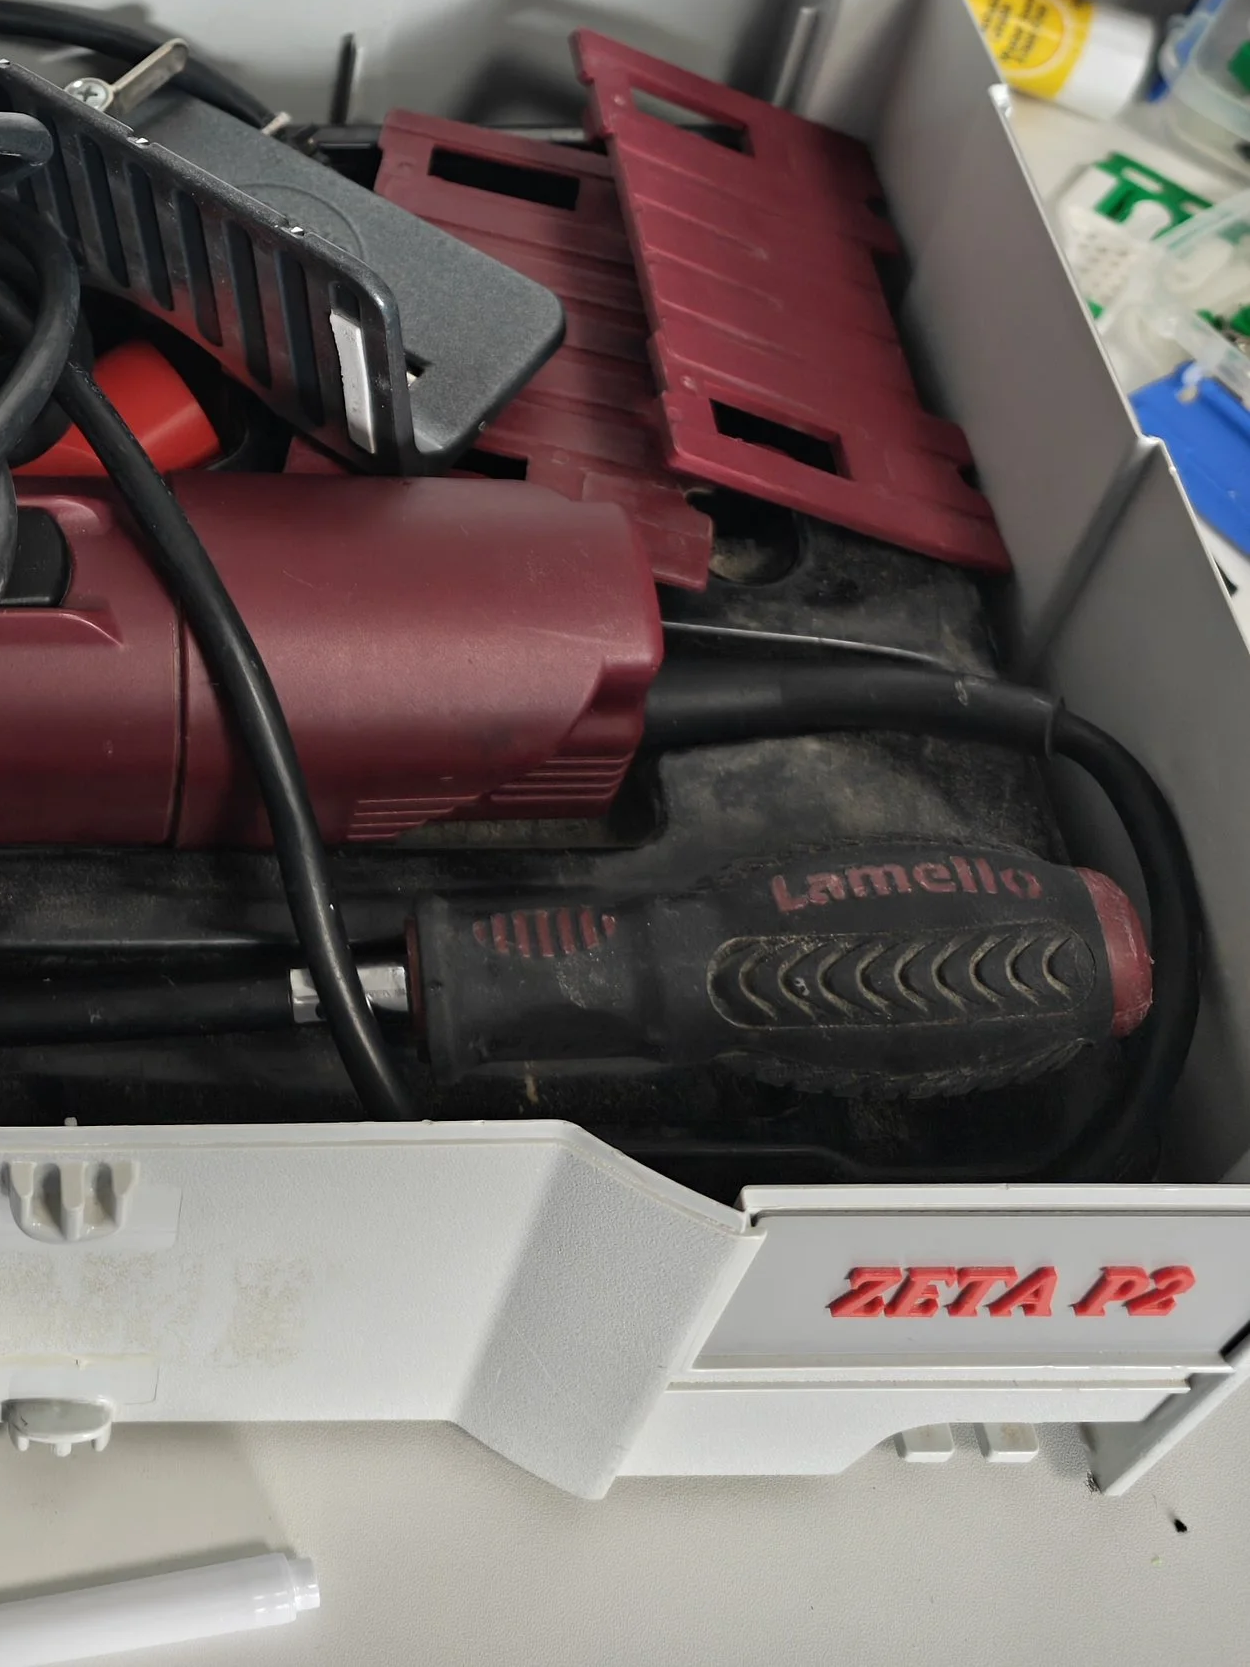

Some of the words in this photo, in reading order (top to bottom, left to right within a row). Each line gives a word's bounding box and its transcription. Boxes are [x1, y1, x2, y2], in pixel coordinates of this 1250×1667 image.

[770, 855, 1042, 913] Lamello
[826, 1265, 1058, 1319] ZETA
[1069, 1265, 1197, 1317] P2
